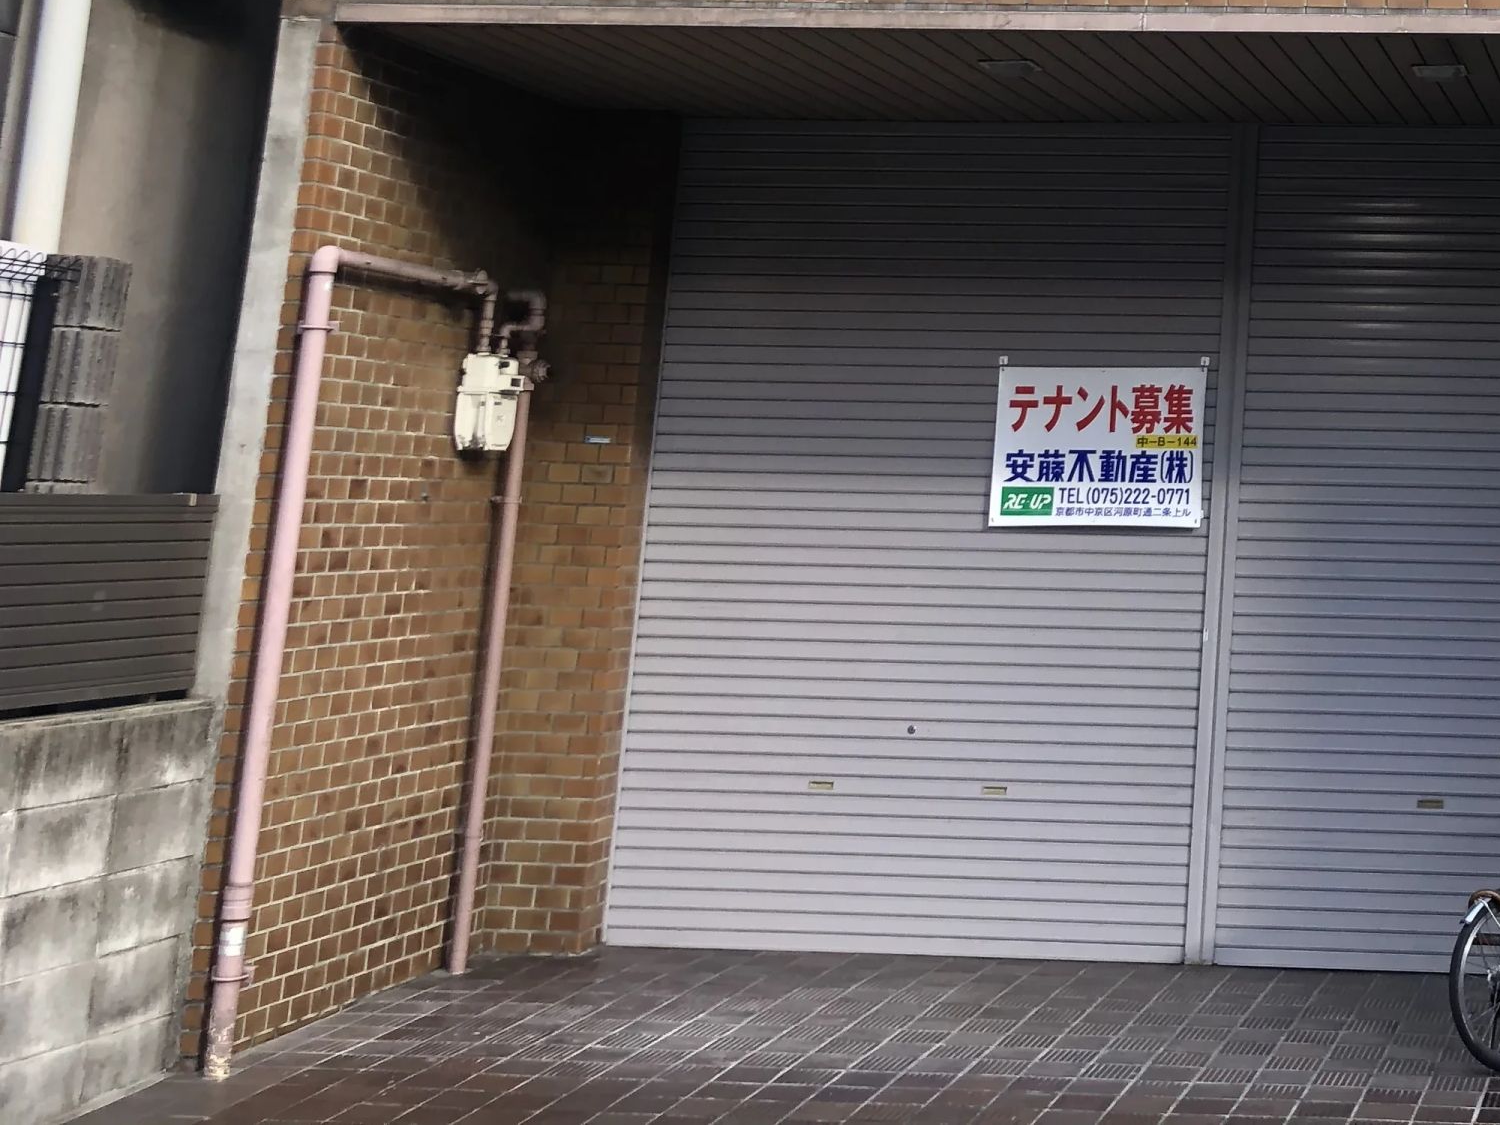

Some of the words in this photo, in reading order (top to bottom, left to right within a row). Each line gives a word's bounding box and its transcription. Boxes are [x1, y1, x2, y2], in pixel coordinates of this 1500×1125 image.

[1009, 384, 1194, 434] テナント募集
